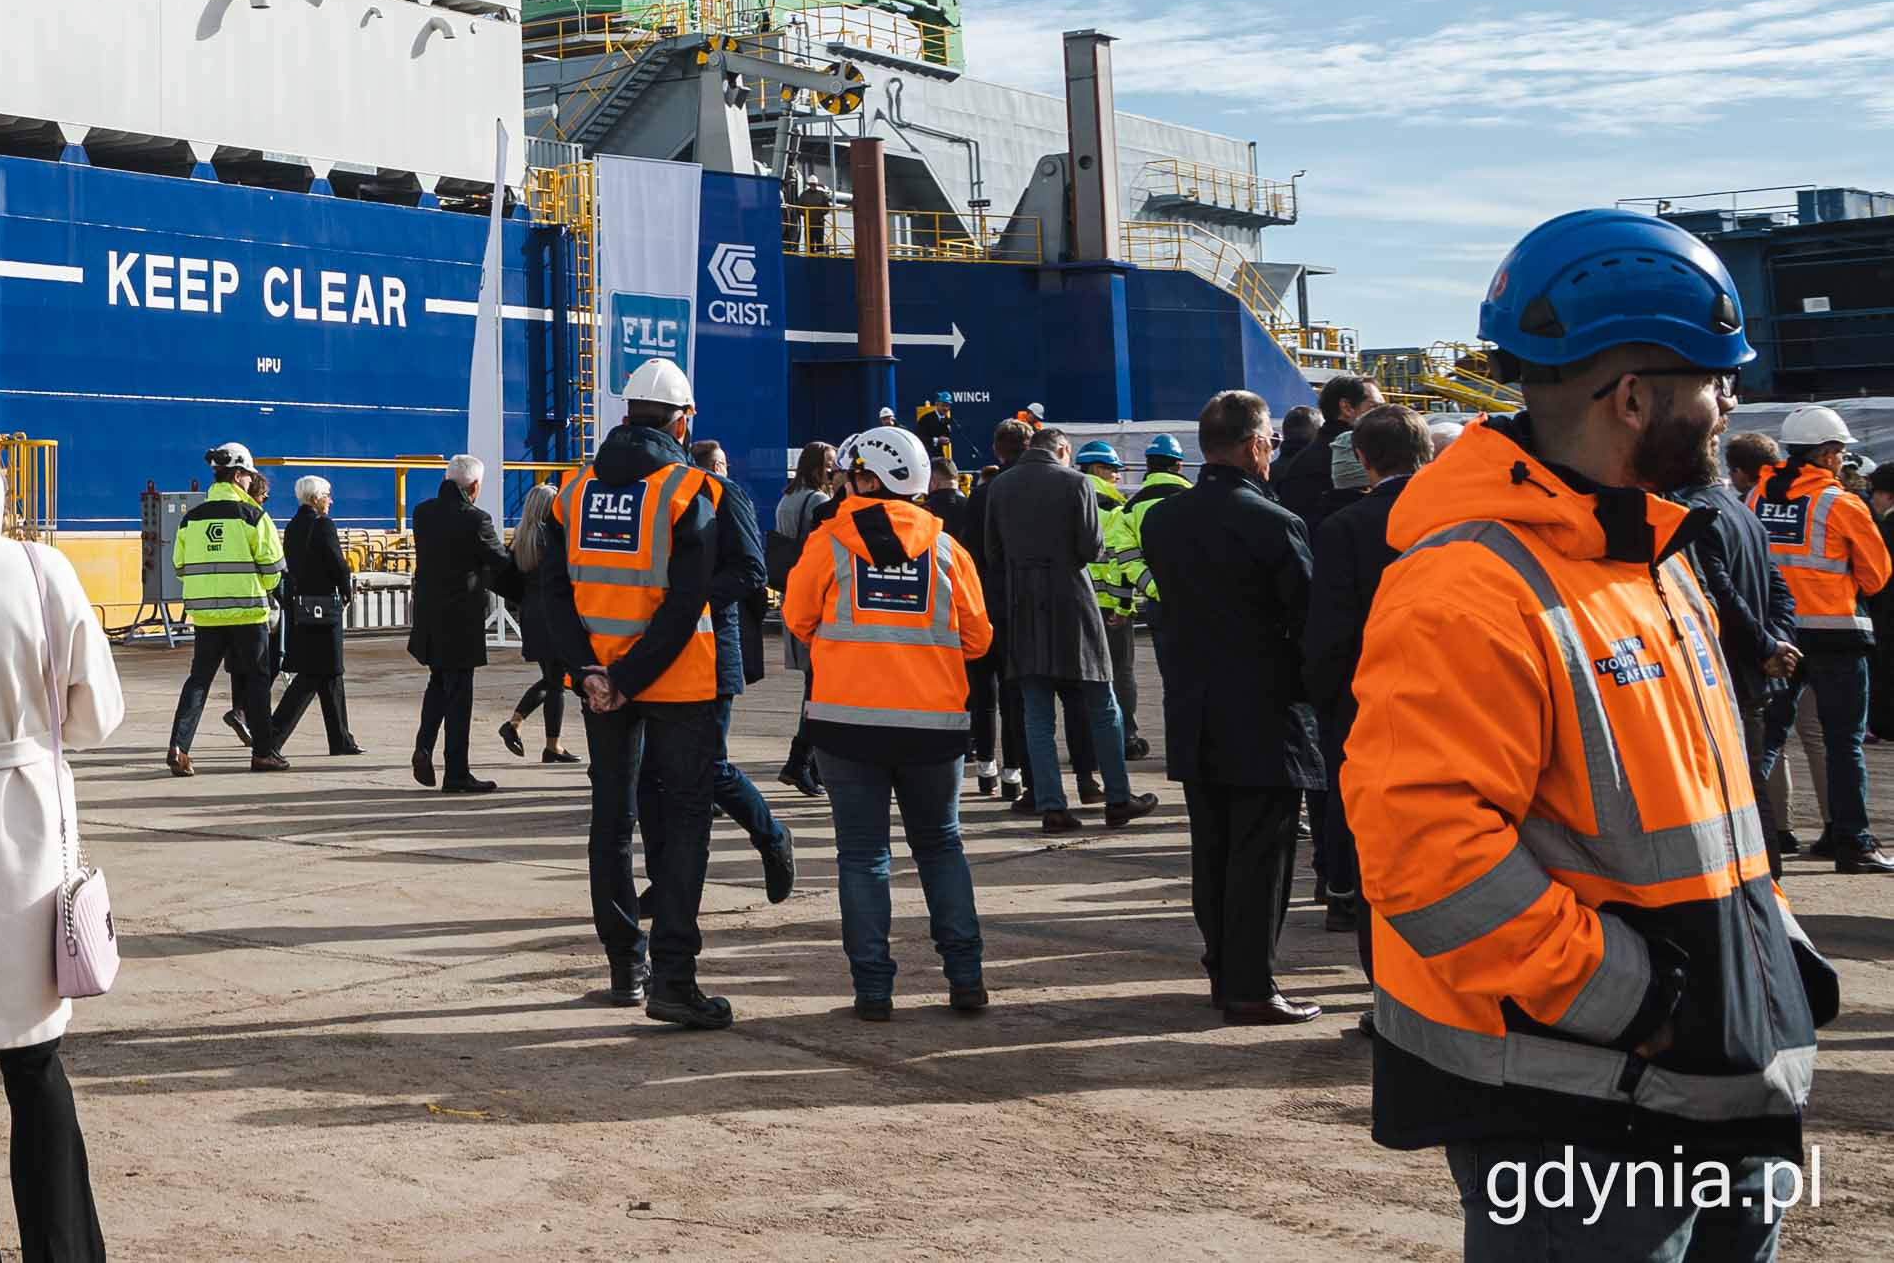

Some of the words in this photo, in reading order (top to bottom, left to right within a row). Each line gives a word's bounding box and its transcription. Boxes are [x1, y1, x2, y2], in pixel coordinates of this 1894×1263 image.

[108, 250, 240, 313] KEEP
[263, 266, 407, 327] CLEAR
[708, 300, 769, 326] CRIST
[622, 316, 678, 348] FLC
[257, 357, 281, 373] HPU
[953, 391, 990, 403] WINCH
[589, 493, 634, 515] FLC
[1761, 503, 1799, 519] FLC
[1596, 654, 1637, 672] YOUR
